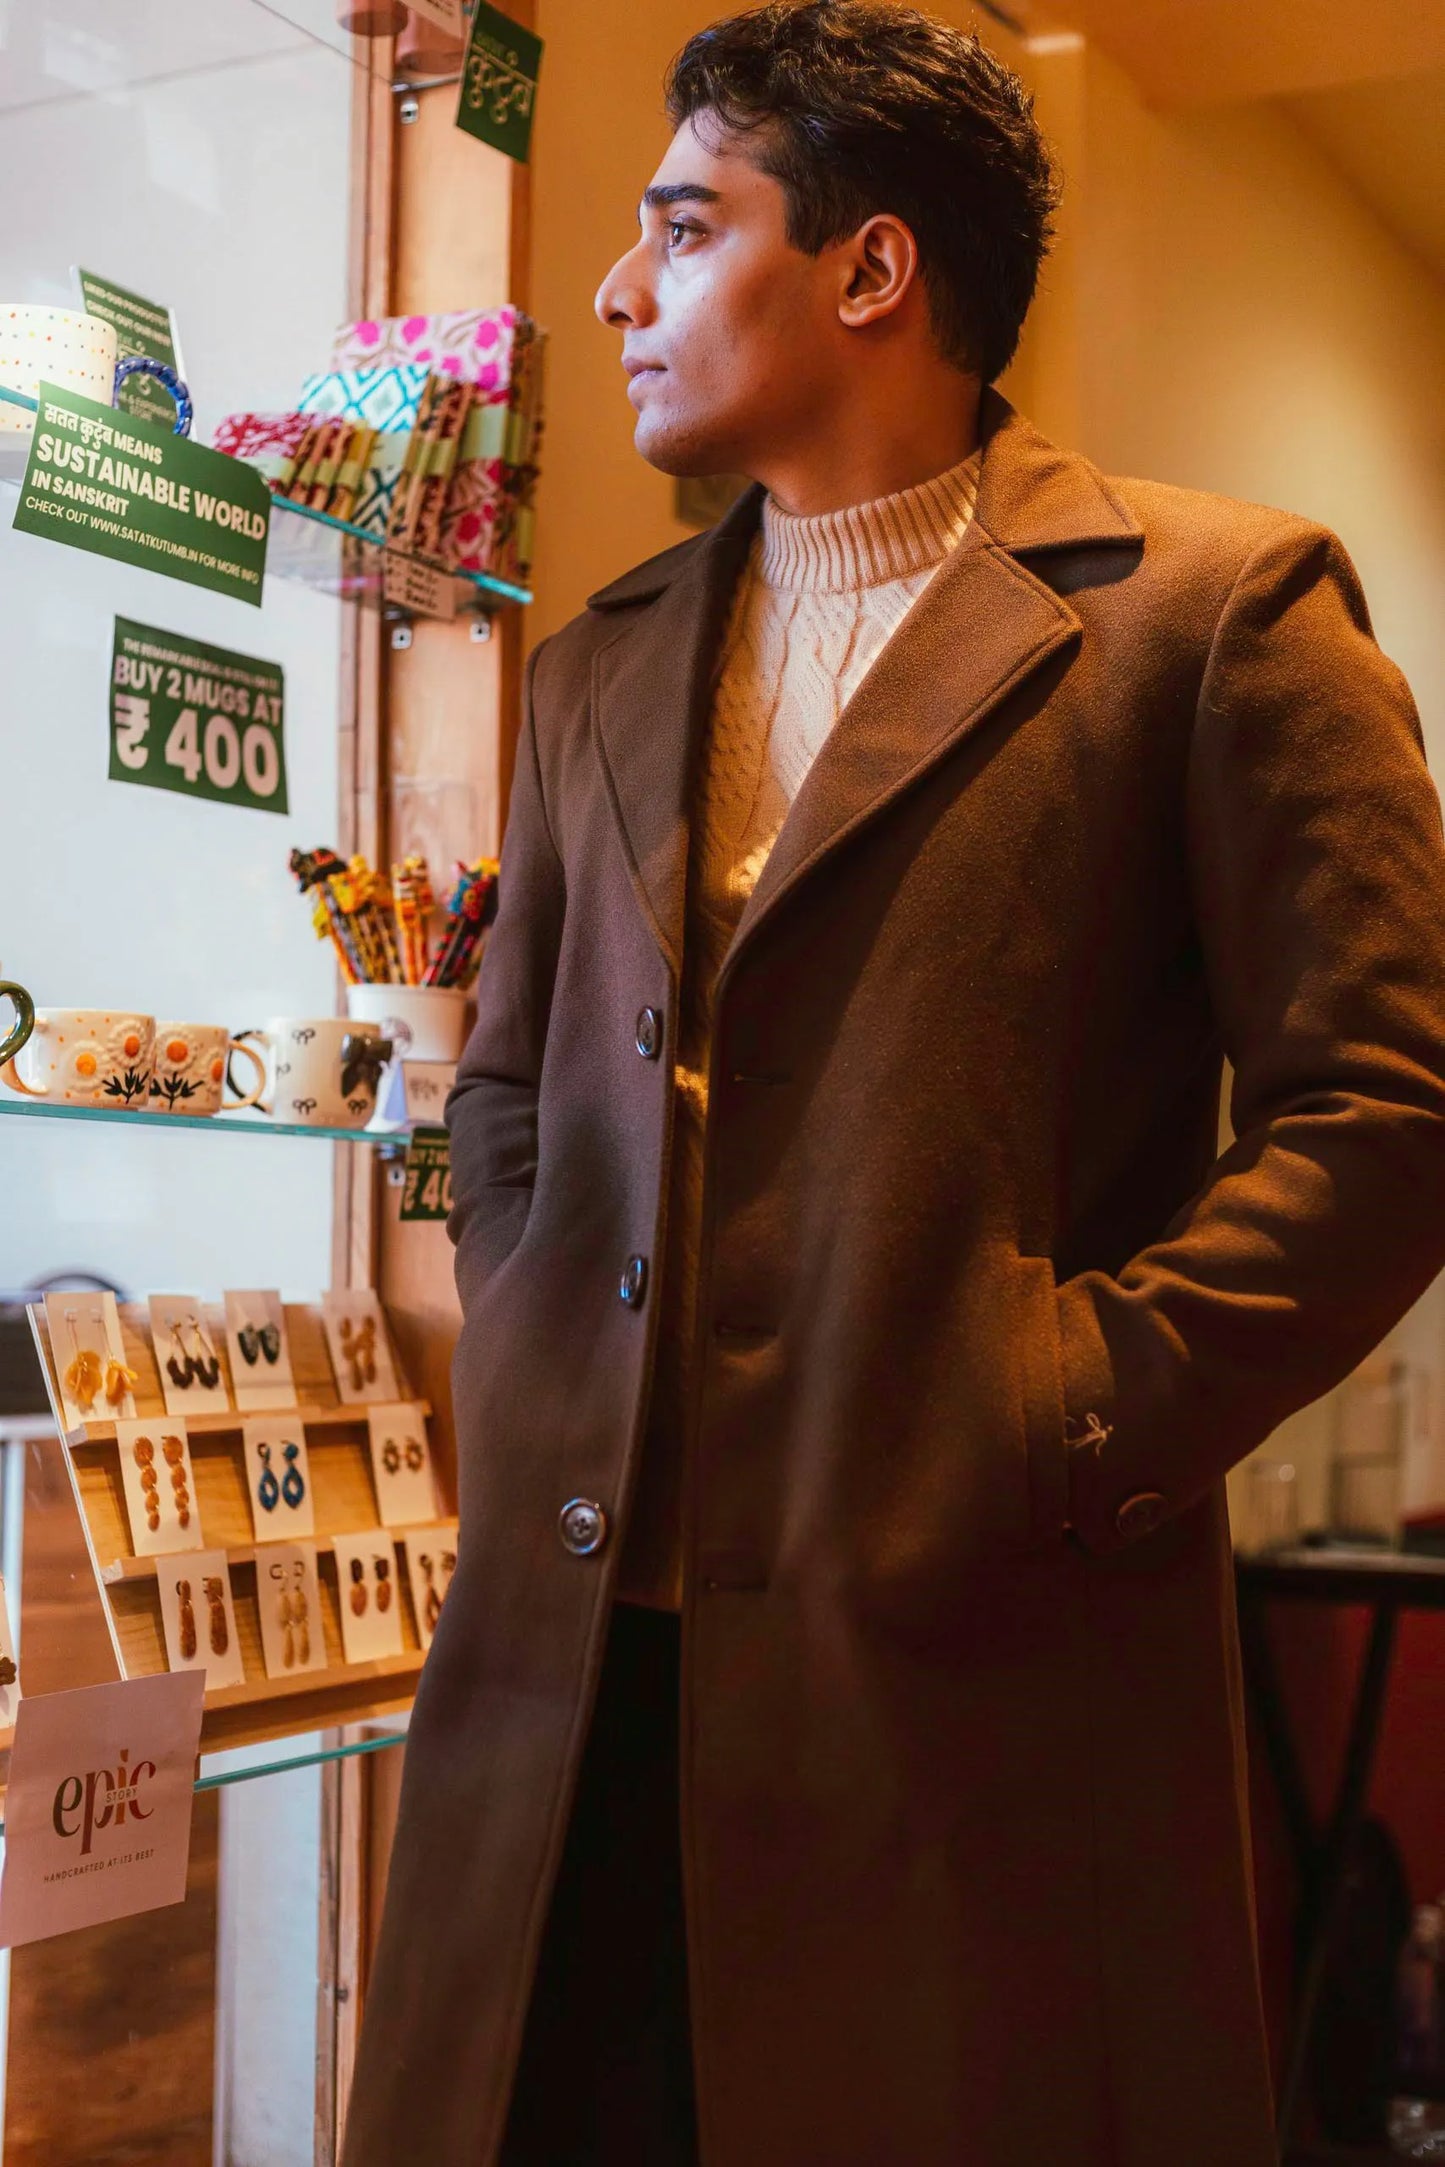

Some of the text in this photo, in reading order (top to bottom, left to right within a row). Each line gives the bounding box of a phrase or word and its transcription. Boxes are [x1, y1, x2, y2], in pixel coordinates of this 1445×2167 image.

[44, 402, 79, 432] सतत
[114, 431, 163, 465] MEANS
[31, 468, 130, 517] IN SANSKRIT
[36, 433, 266, 541] SUSTAINABLE WORLD
[25, 496, 65, 518] CHECK
[66, 508, 88, 525] OUT
[199, 552, 217, 569] FOR
[217, 560, 241, 578] MORE
[114, 655, 163, 695] BUY
[166, 668, 182, 699] 2
[184, 674, 250, 717] MUGS
[252, 693, 283, 726] AT
[114, 693, 280, 798] ₹ 400
[52, 1748, 157, 1856] epic
[105, 1787, 138, 1803] STORY
[43, 1861, 104, 1883] HANDCRAFTED
[107, 1858, 117, 1868] AT
[135, 1849, 154, 1861] BEST
